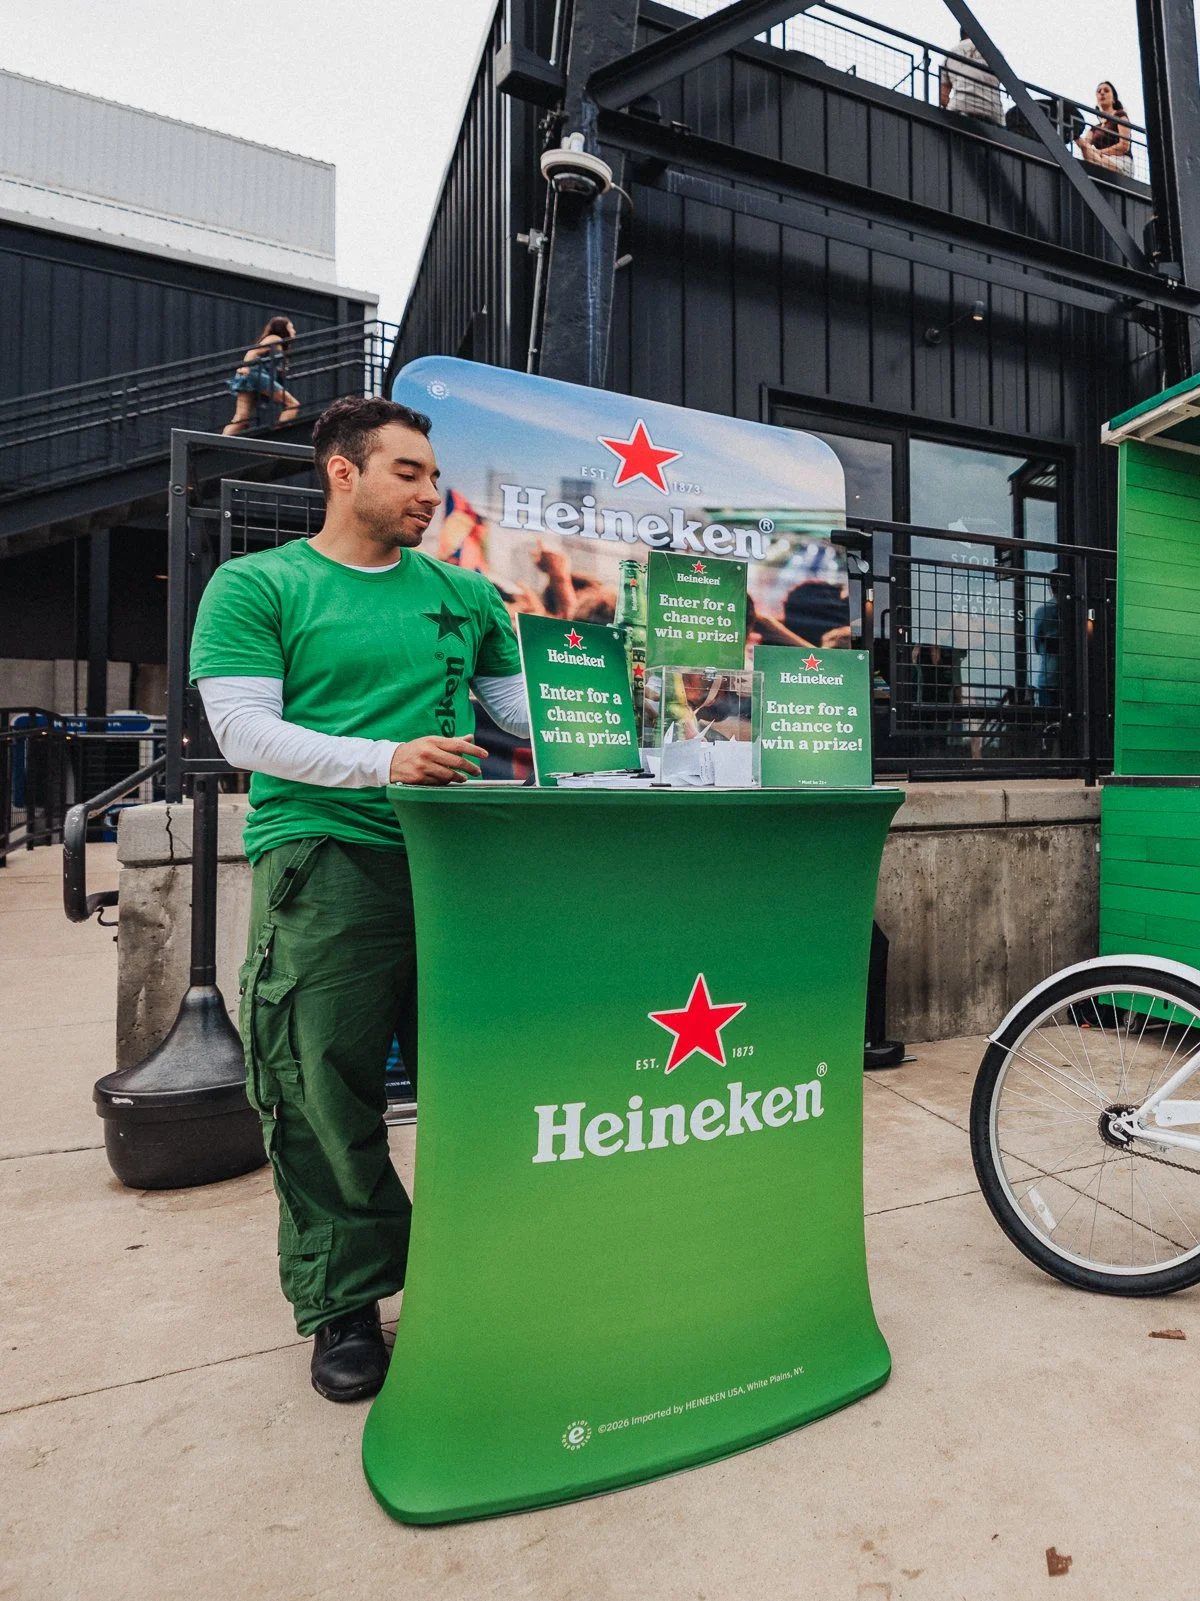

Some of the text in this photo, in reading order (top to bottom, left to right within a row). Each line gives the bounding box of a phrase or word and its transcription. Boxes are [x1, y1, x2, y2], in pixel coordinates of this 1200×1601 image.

[581, 466, 702, 494] EST. 1873
[659, 594, 736, 612] Enter for a
[952, 589, 1000, 604] GUEST
[663, 610, 732, 627] chance to
[952, 604, 1024, 621] SERVICES
[655, 626, 739, 643] win a prize!
[539, 683, 622, 705] Enter for a
[547, 706, 620, 724] chance to
[766, 701, 857, 716] Enter for a
[770, 719, 853, 734] chance to
[540, 727, 631, 747] win a prize!
[761, 736, 862, 753] win a prize!
[635, 1045, 754, 1071] EST. 1873
[631, 1406, 671, 1426] Imported
[673, 1404, 684, 1416] by
[685, 1391, 726, 1411] HEINEKEN
[727, 1386, 746, 1398] USA,
[747, 1378, 768, 1392] White
[770, 1370, 793, 1385] Plains,
